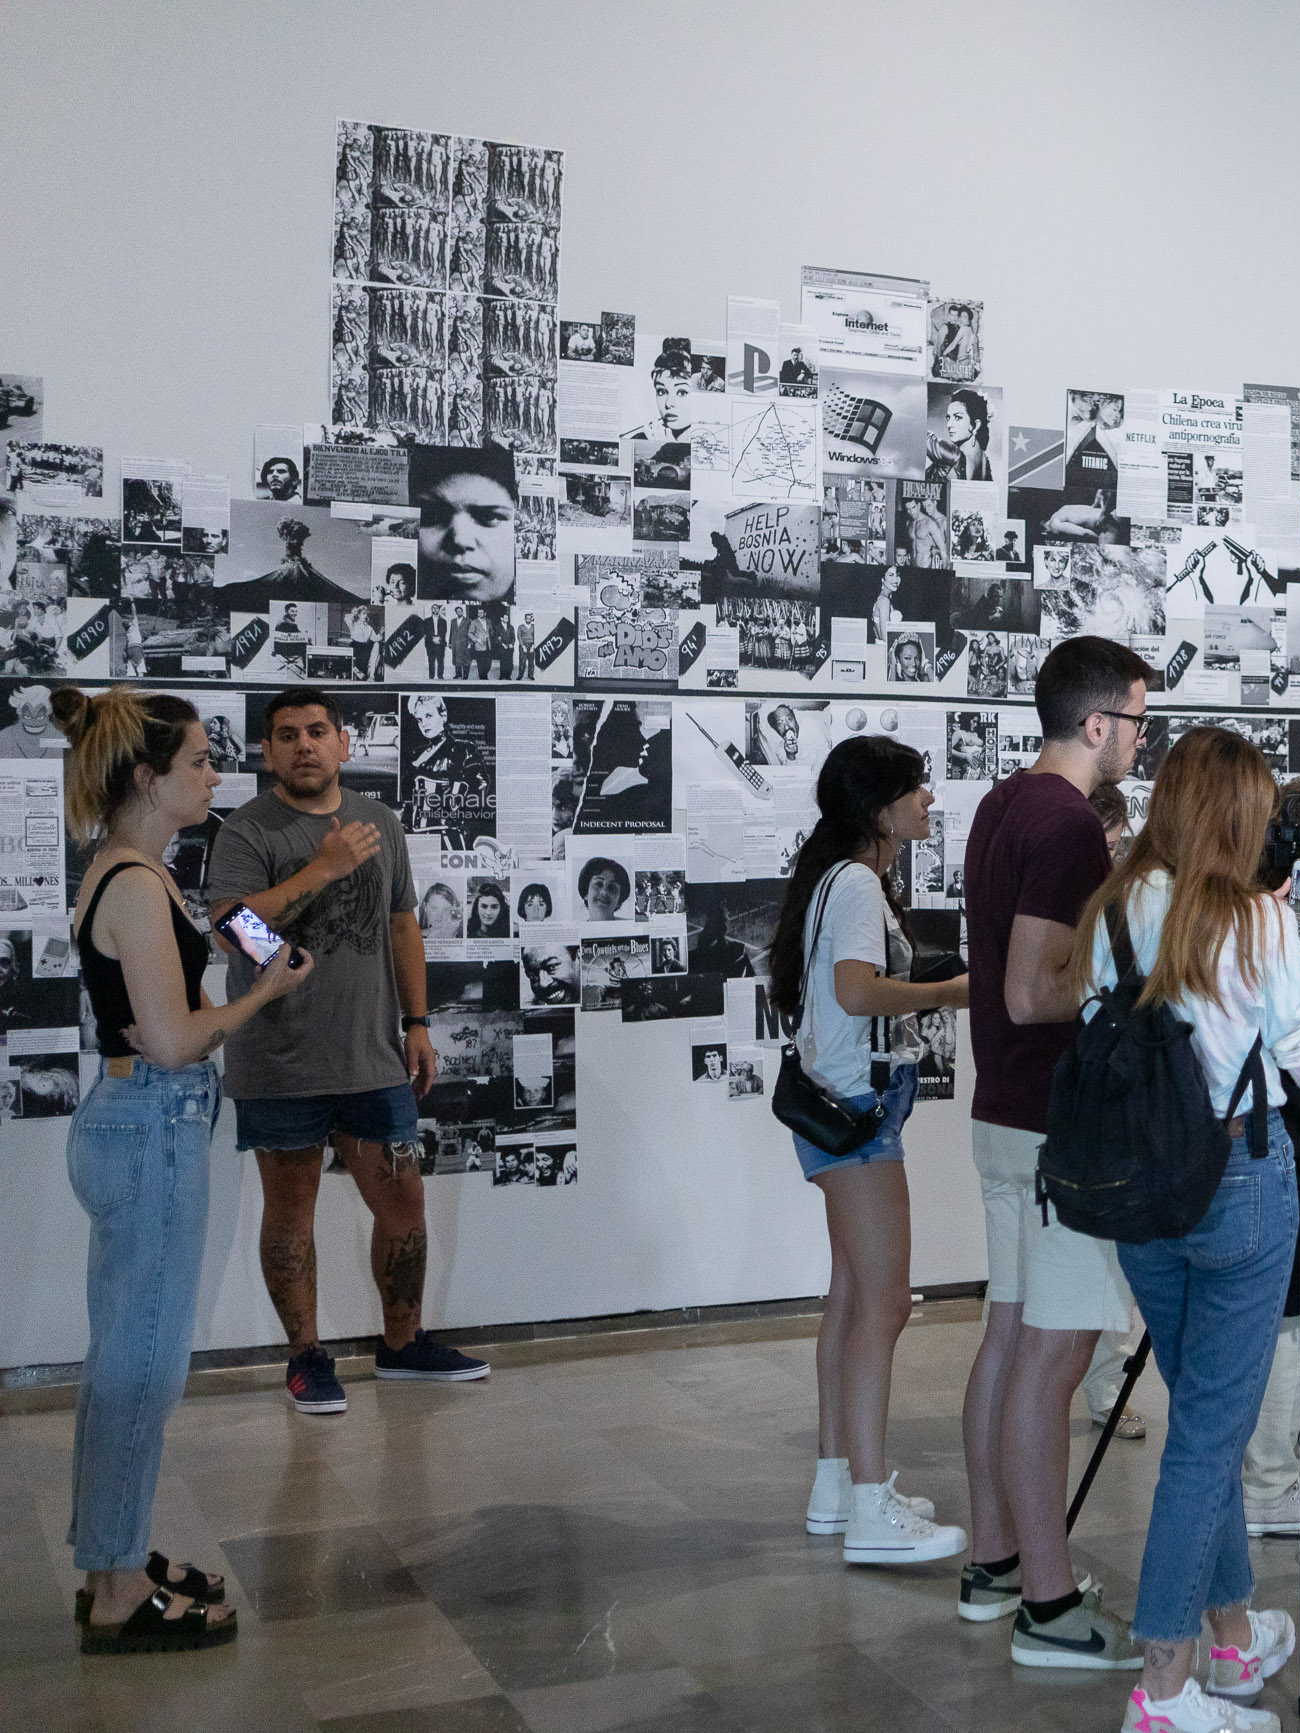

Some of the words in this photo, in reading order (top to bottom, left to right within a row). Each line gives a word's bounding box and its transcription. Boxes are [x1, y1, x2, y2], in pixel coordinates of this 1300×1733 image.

[845, 318, 889, 332] Internet
[1172, 392, 1188, 405] La
[1191, 394, 1225, 409] Epoca
[1162, 412, 1198, 428] Chilena
[1201, 420, 1221, 429] crea
[1223, 418, 1243, 431] viru
[1125, 432, 1157, 444] NETFLIX
[312, 444, 360, 454] BIENVENIDOS
[360, 447, 369, 455] AL
[369, 448, 389, 457] EJIDO
[827, 451, 880, 465] Windows
[879, 455, 894, 466] 95
[1081, 455, 1108, 470] TITANIC
[902, 481, 943, 500] HUNGARY
[744, 506, 790, 534] HELP
[739, 527, 792, 550] BOSNIA
[746, 548, 807, 577] NOW
[76, 620, 105, 649] 1990
[235, 623, 263, 657] 1991
[388, 630, 415, 658] 1992
[538, 635, 563, 662] 1993
[681, 635, 698, 658] 94'
[1150, 645, 1160, 653] del
[613, 644, 668, 671] AMO
[936, 651, 956, 674] 1996
[1143, 653, 1156, 661] Che
[1168, 649, 1188, 678] 1998
[954, 712, 996, 723] CRK
[985, 728, 997, 773] HOTEL
[360, 790, 382, 800] 1991
[415, 788, 497, 809] female
[418, 808, 497, 820] misbehavior
[580, 820, 622, 828] INDECENT
[624, 820, 666, 828] PROPOSAL
[592, 943, 617, 957] Cowgirls
[630, 939, 649, 954] Blues
[918, 1076, 941, 1084] ESTRO
[919, 1083, 954, 1096] SONA
